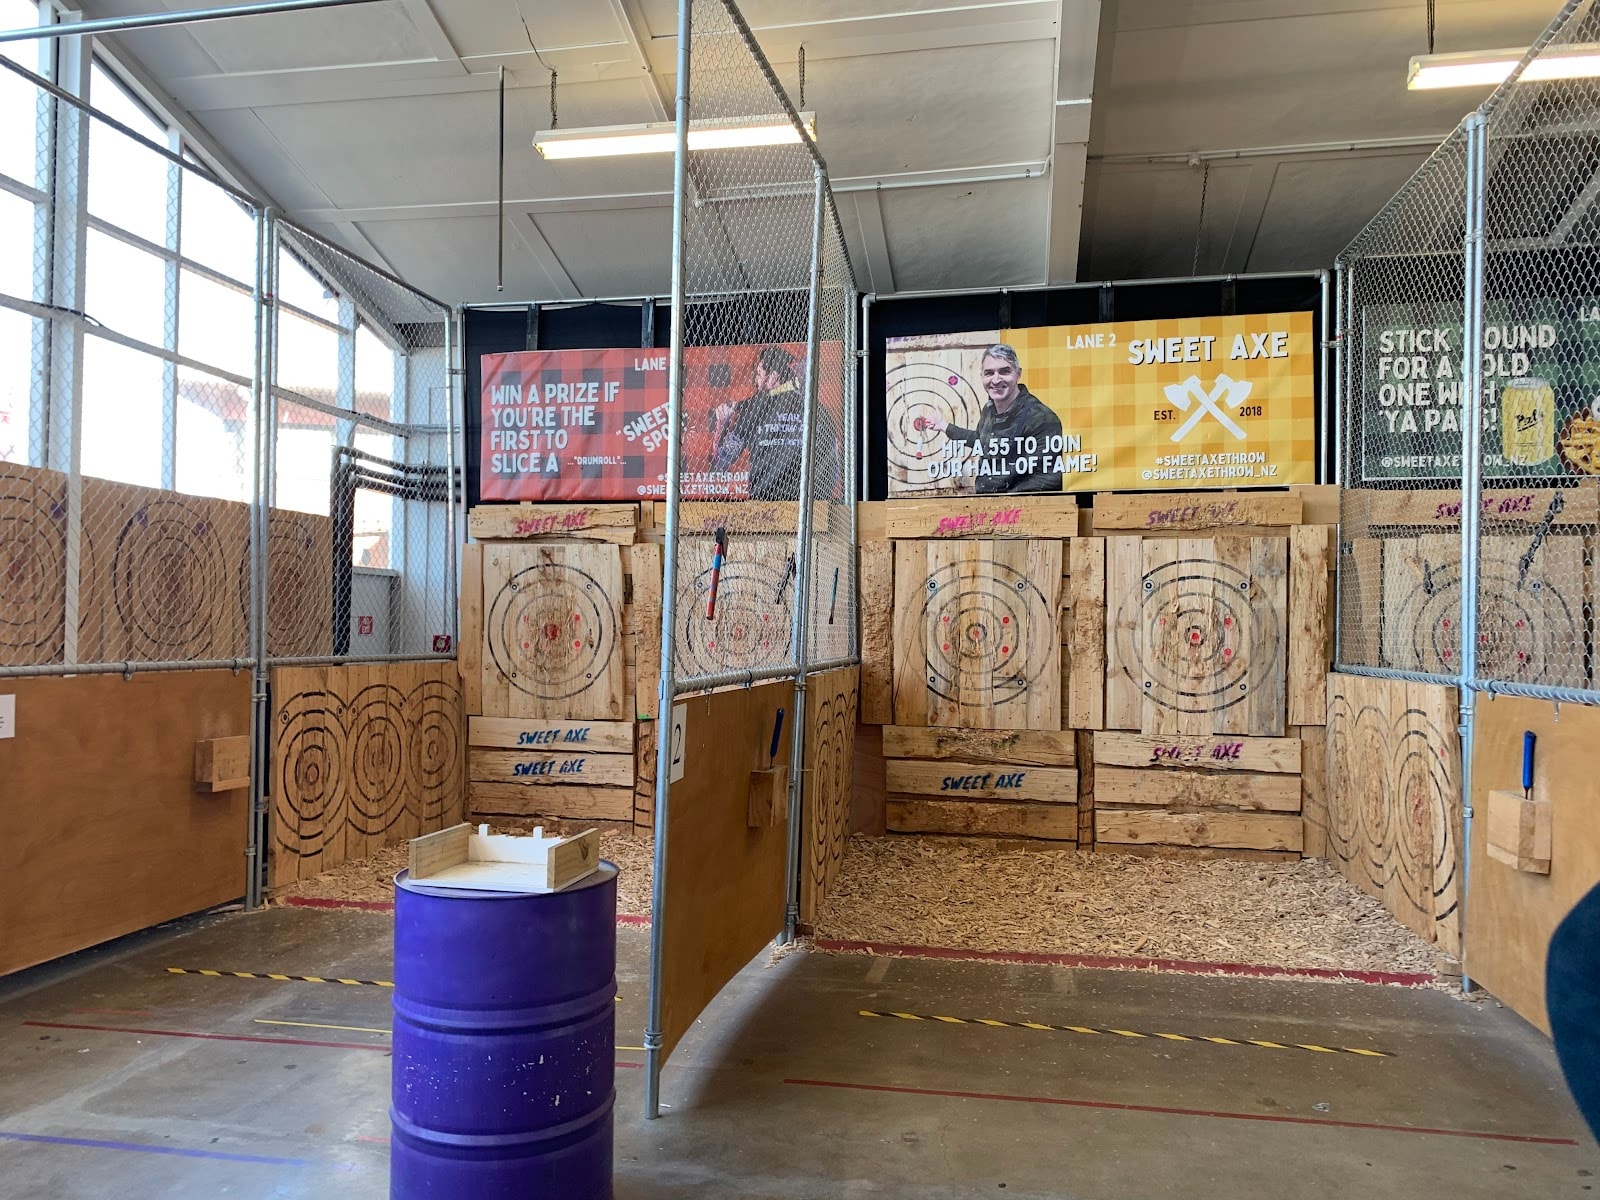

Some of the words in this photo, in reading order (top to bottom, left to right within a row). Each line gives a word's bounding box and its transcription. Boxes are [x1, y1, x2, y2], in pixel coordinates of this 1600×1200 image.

[1066, 334, 1105, 350] LANE
[1108, 333, 1117, 347] 2
[1128, 336, 1216, 366] SWEET
[1230, 332, 1289, 360] AXE
[1379, 328, 1452, 353] STICK
[634, 357, 667, 371] LANE
[1378, 356, 1428, 380] FOR
[1436, 355, 1454, 380] A
[1461, 352, 1531, 377] OLD
[491, 384, 523, 405] WIN
[527, 384, 540, 404] A
[545, 382, 600, 404] PRIZE
[604, 382, 620, 402] IF
[1378, 382, 1431, 406] ONE
[1438, 380, 1496, 406] WIH
[491, 407, 557, 428] YOU'RE
[561, 406, 596, 427] THE
[1153, 410, 1177, 421] EST.
[1239, 406, 1263, 417] 2018
[490, 429, 541, 451] FIRST
[545, 429, 568, 450] TO
[941, 440, 967, 458] HIT
[971, 439, 984, 457] A
[988, 437, 1010, 455] 55
[1014, 436, 1038, 455] TO
[1042, 434, 1082, 454] JOIN
[491, 452, 541, 474] SLICE
[545, 452, 559, 473] A
[927, 460, 963, 478] OUR
[969, 459, 1011, 477] HALL
[1015, 456, 1039, 475] OF
[1042, 454, 1098, 474] FAME!
[1155, 452, 1266, 467] #SWEETAXETHROW
[1142, 465, 1278, 481] @SWEETAXETHROW_NZ
[516, 729, 561, 745] SWEET
[563, 727, 591, 742] AXE
[673, 723, 682, 765] 2
[1211, 742, 1244, 760] AXE
[513, 761, 556, 776] SWEET
[559, 759, 586, 774] AXE
[940, 774, 991, 791] SWEET
[994, 773, 1026, 789] AXE
